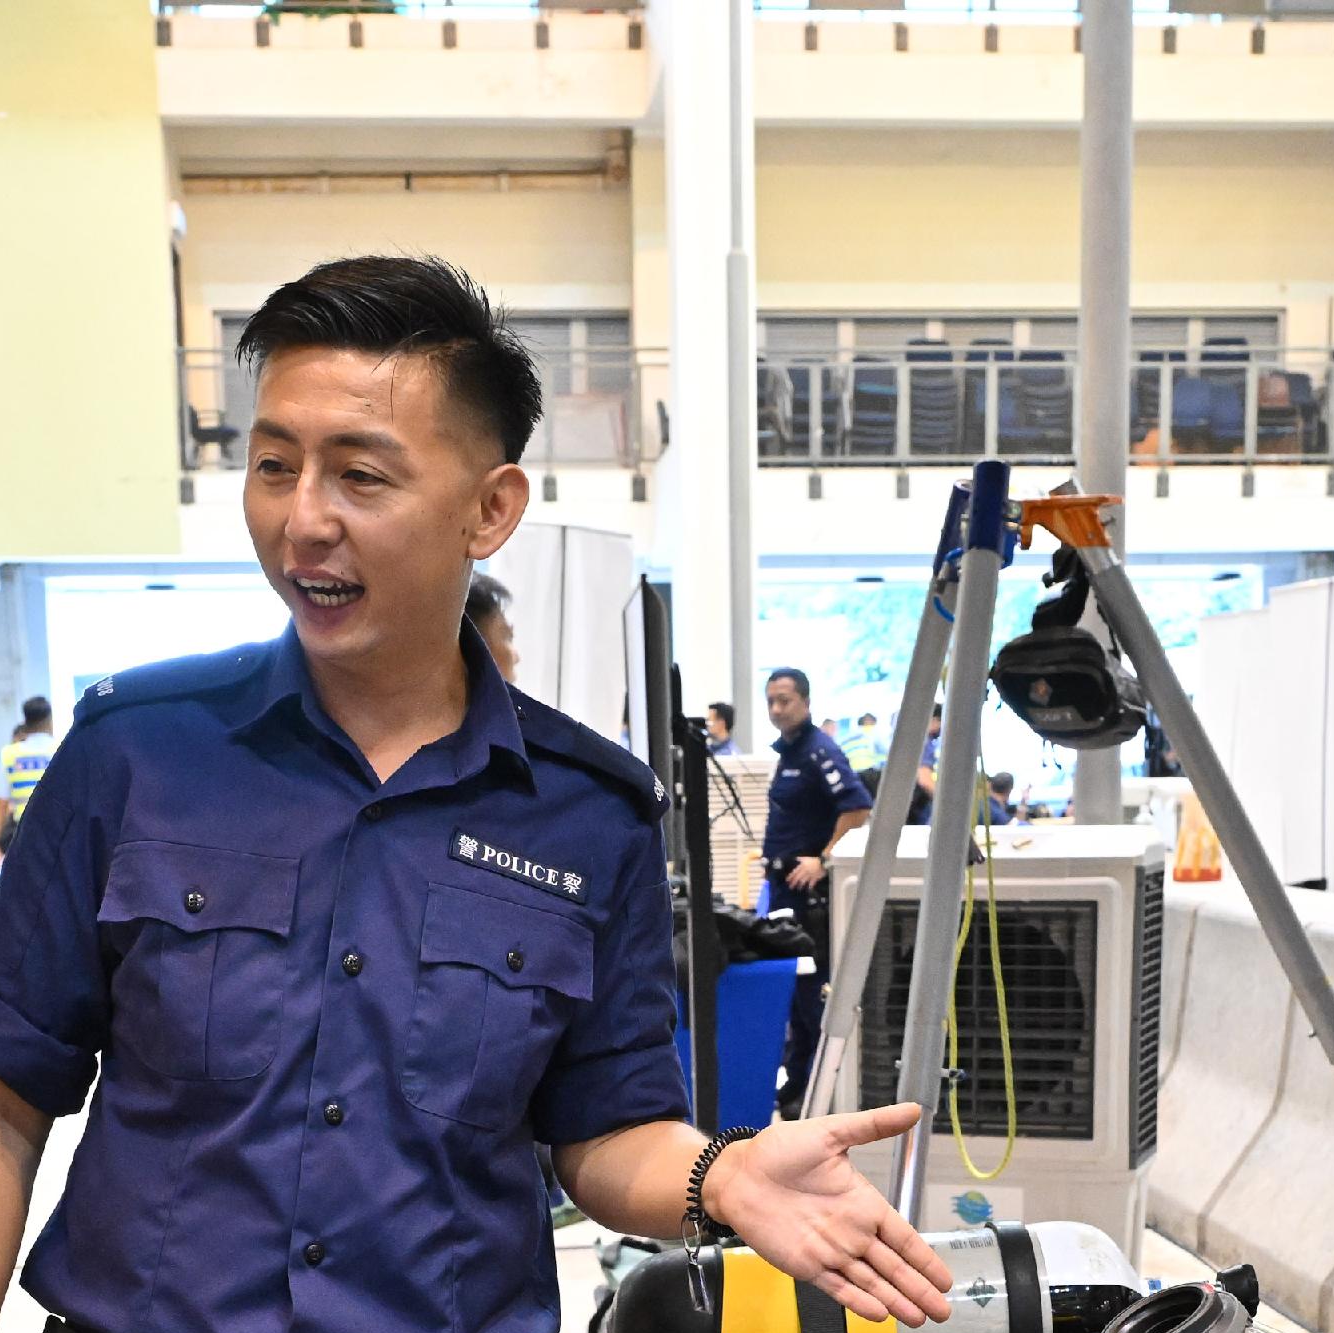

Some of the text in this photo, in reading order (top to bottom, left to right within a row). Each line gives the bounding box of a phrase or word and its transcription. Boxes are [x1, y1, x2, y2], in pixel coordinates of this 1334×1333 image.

[458, 834, 583, 895] 警 POLICE 察
